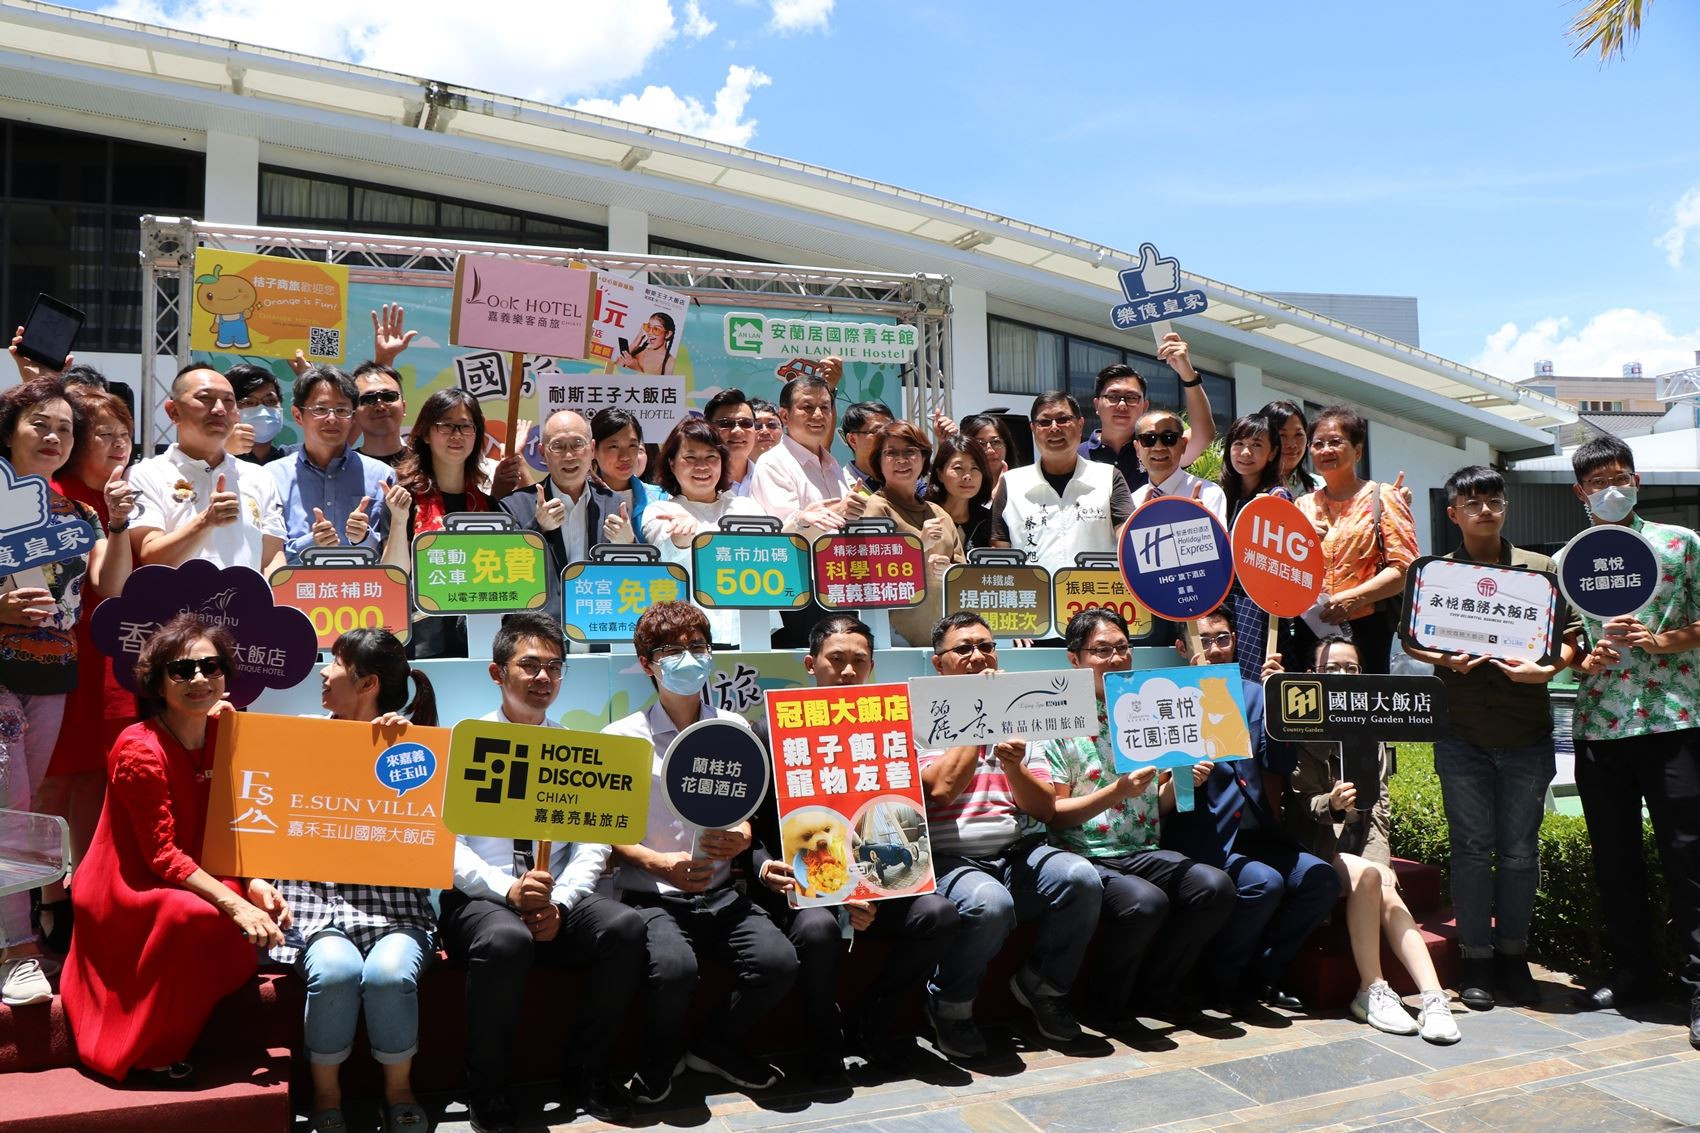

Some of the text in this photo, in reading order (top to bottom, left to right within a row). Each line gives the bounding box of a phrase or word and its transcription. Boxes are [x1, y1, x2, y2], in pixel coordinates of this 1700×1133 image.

[253, 276, 336, 296] 桔子商旅歡迎您
[264, 298, 300, 308] Orange
[526, 299, 582, 318] HOTEL
[1117, 293, 1204, 325] 樂億皇家
[488, 311, 560, 329] 嘉義樂客商旅
[771, 324, 914, 346] 安蘭居國際青年館
[781, 344, 905, 359] AN LAN JIE Hostel
[548, 386, 677, 404] 耐斯王子大飯店
[640, 409, 675, 420] HOTEL
[833, 543, 903, 556] 精彩暑期活動
[1178, 536, 1201, 545] Holiday
[1180, 543, 1214, 556] Express
[427, 549, 466, 565] 電動
[715, 547, 788, 562] 嘉市加碼
[472, 547, 536, 584] 免費
[1243, 547, 1313, 590] 洲際酒店集團
[428, 569, 467, 585] 公車
[982, 574, 1014, 586] 林鐵處
[1579, 573, 1641, 591] 花園酒店
[296, 582, 382, 599] 國旅補助
[447, 590, 518, 602] 以電子票證搭乘
[575, 579, 613, 595] 故宮
[827, 582, 915, 603] 嘉義藝術節
[1066, 581, 1131, 595] 振興三倍
[575, 599, 613, 615] 門票
[960, 590, 1037, 608] 提前購票
[1178, 595, 1198, 604] CHIAYI
[308, 605, 384, 636] 000
[977, 612, 1037, 631] 開班次
[1328, 691, 1432, 712] 國園大飯店
[776, 694, 909, 728] 冠閣大飯店
[1328, 714, 1434, 725] Country Garden Hotel
[1123, 722, 1199, 750] 花園酒店
[1282, 726, 1304, 734] Country
[541, 743, 603, 766] HOTEL
[782, 730, 908, 767] 親子飯店
[386, 749, 425, 767] 來嘉義
[692, 756, 742, 778] 蘭桂坊
[389, 765, 428, 782] 住玉山
[538, 767, 633, 792] DISCOVER
[786, 760, 912, 798] 寵物友善
[681, 775, 748, 799] 花園酒店
[290, 794, 437, 818] E.SUN VILLA
[536, 791, 578, 804] CHIAYI
[534, 808, 629, 828] 嘉義亮點旅店
[287, 821, 436, 846] 嘉禾玉山國際大飯店
